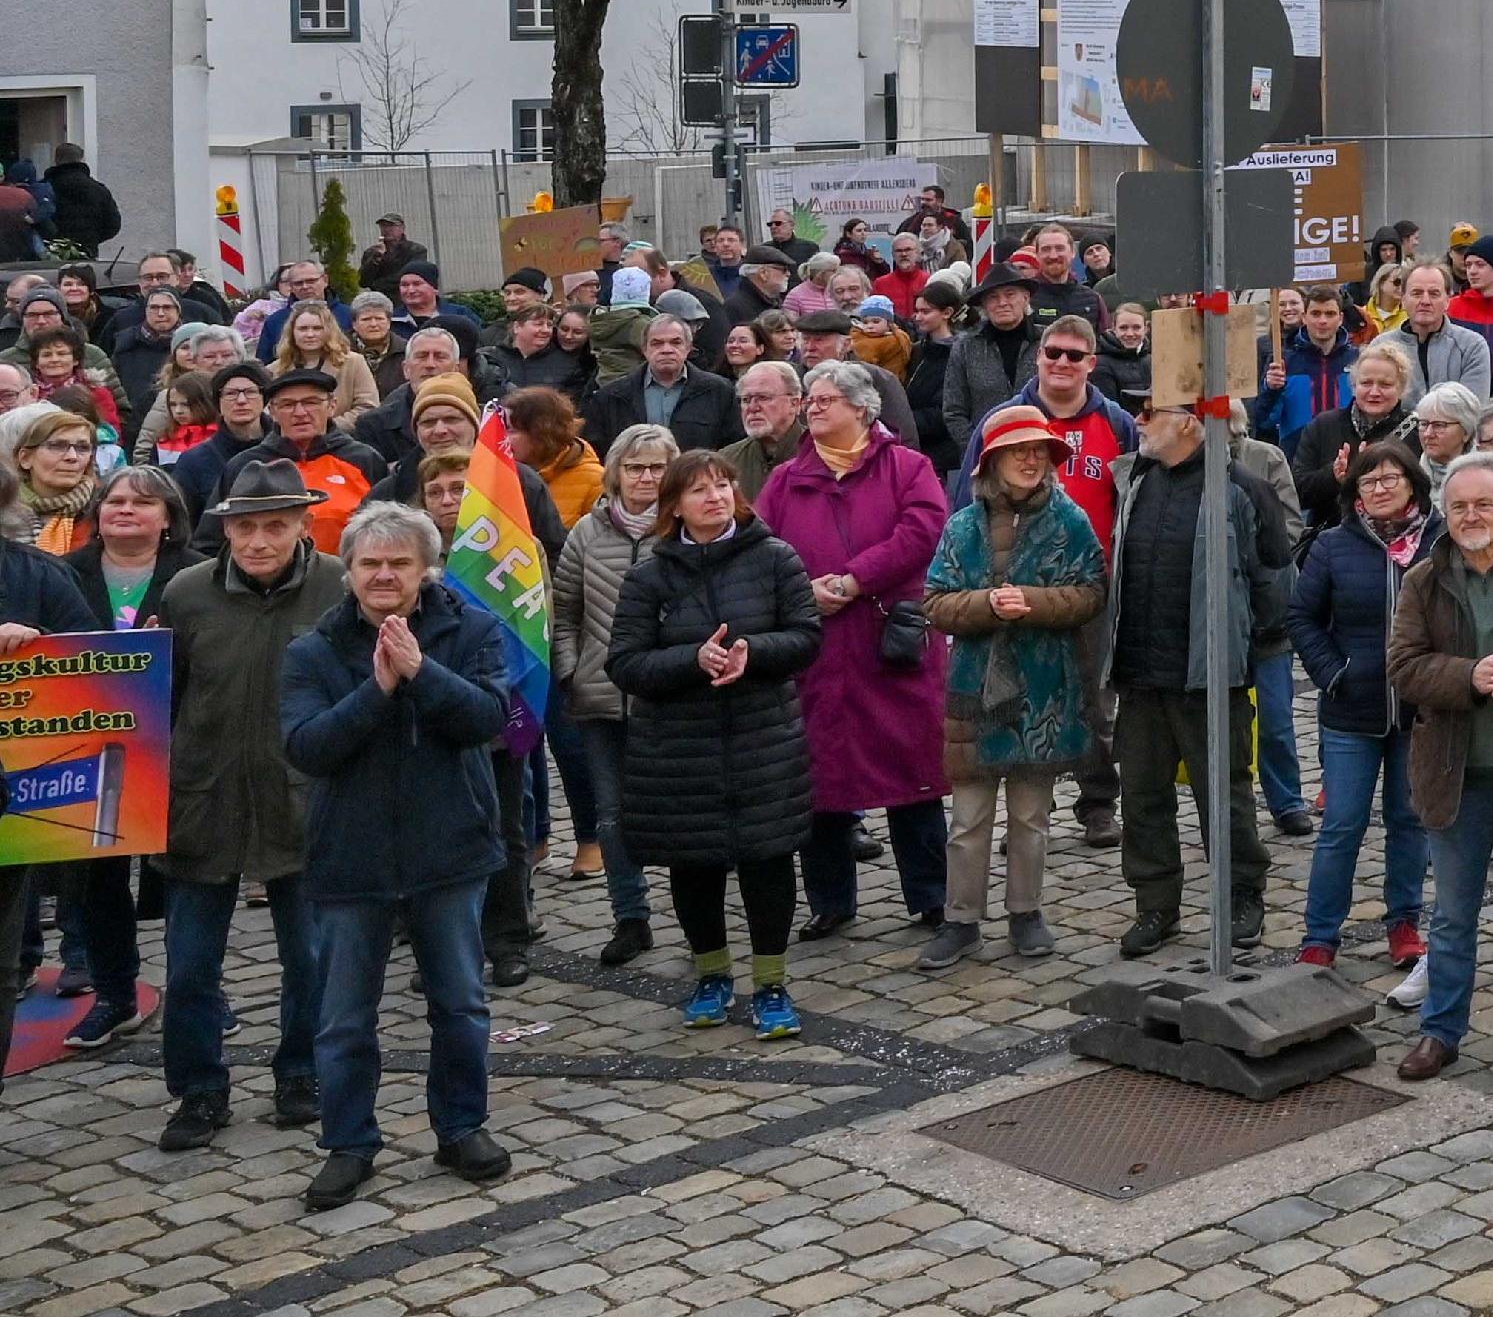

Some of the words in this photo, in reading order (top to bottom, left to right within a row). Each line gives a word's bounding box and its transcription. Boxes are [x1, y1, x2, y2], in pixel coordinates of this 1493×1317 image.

[1246, 153, 1334, 166] Auslieferung
[0, 651, 152, 683] gskultur
[17, 768, 87, 803] Straße
